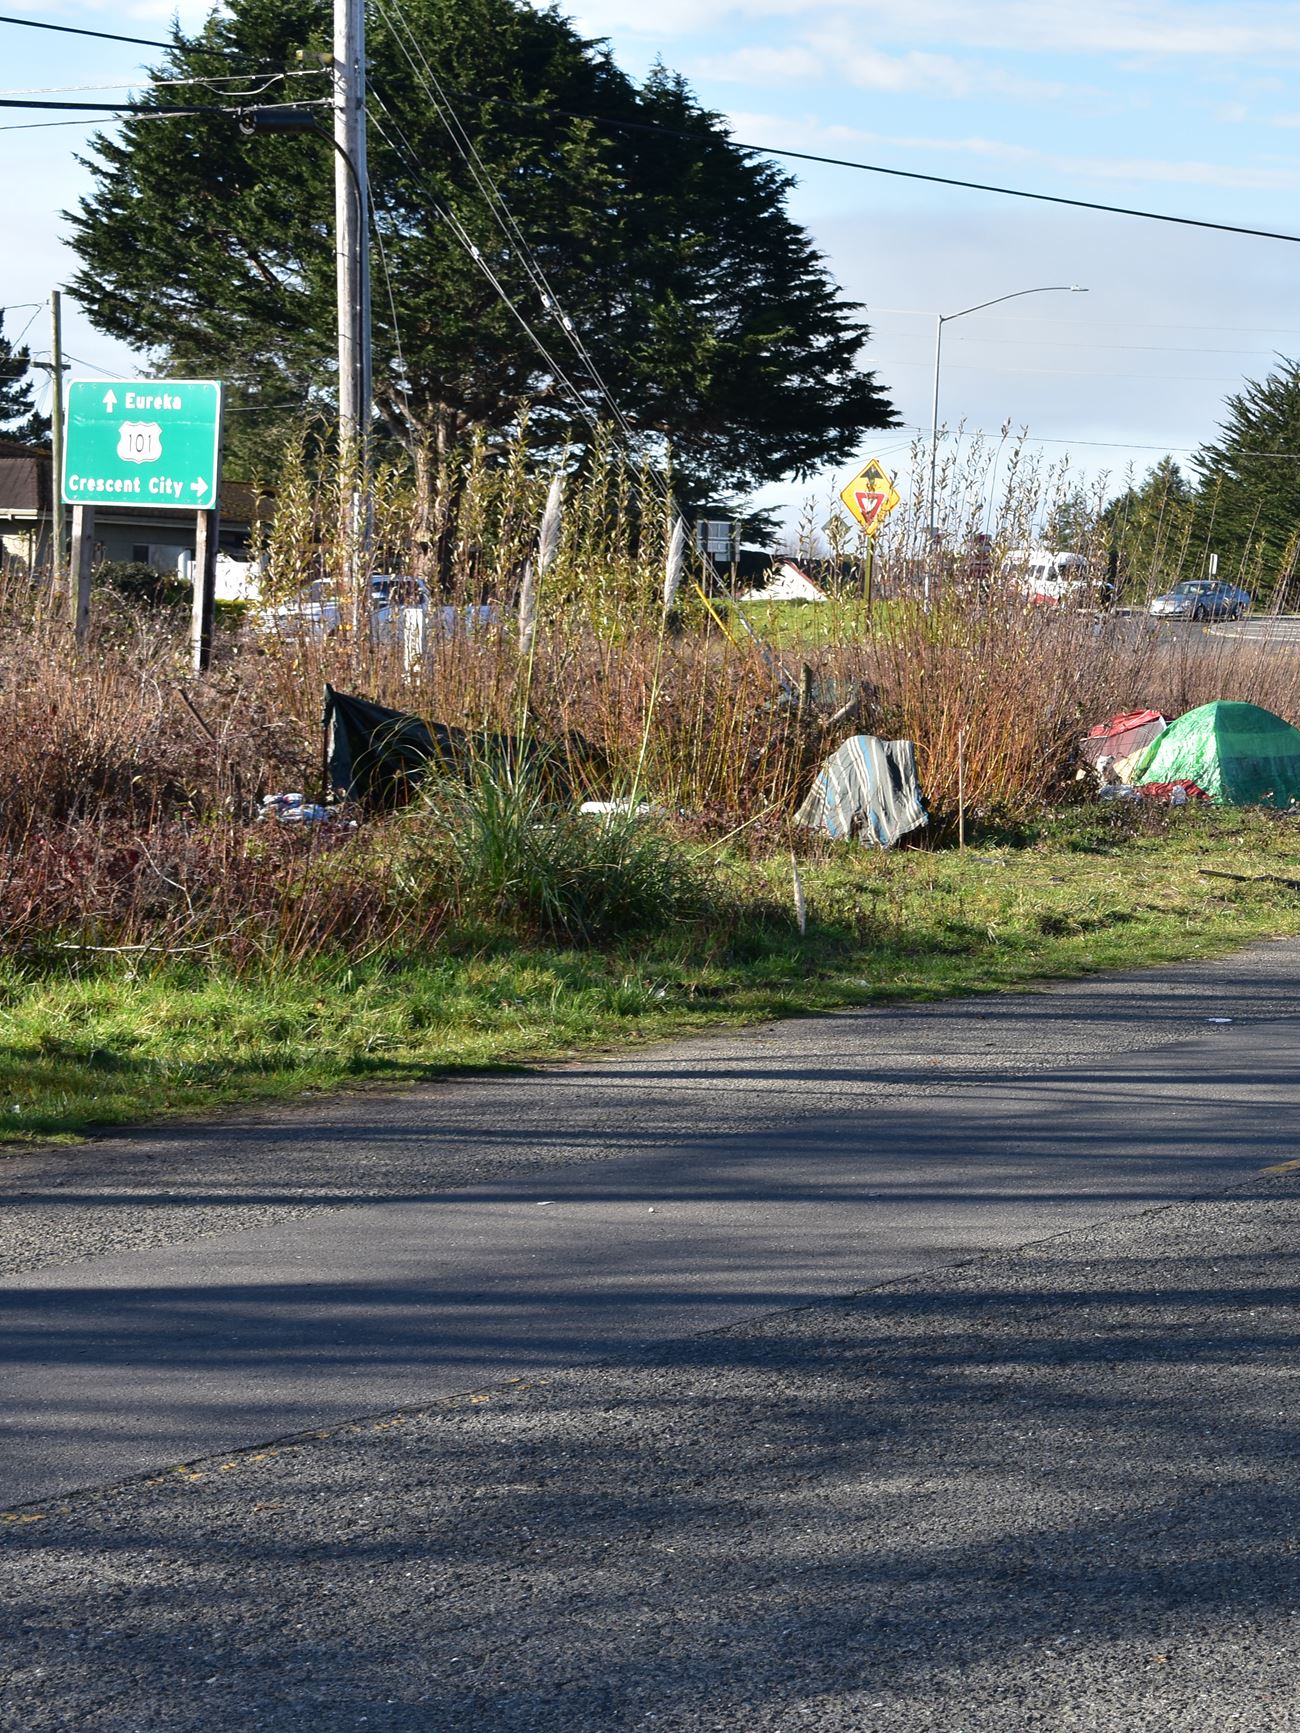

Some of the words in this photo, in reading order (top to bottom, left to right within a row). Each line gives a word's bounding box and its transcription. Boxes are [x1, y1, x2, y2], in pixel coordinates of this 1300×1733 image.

[125, 392, 182, 410] Eureka
[129, 433, 152, 453] 101
[69, 474, 141, 493] Crescent
[148, 476, 183, 498] City
